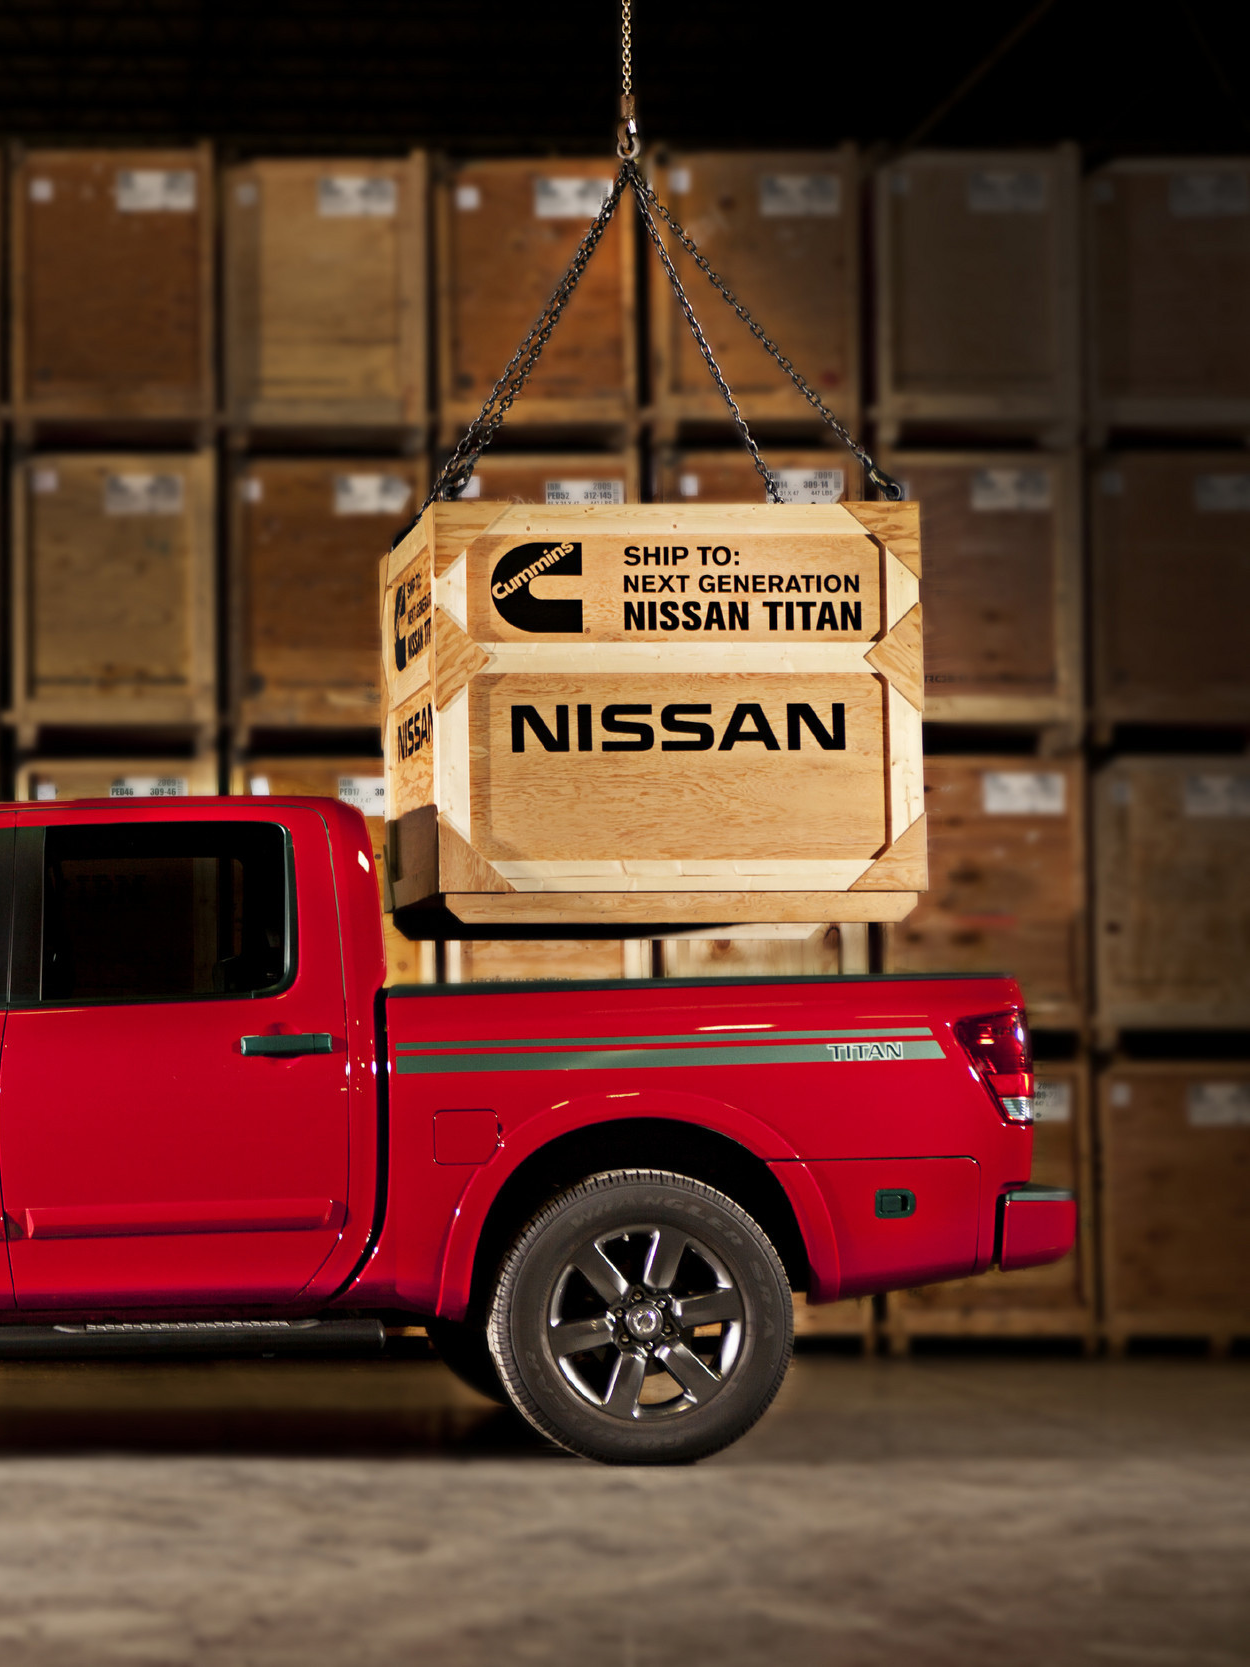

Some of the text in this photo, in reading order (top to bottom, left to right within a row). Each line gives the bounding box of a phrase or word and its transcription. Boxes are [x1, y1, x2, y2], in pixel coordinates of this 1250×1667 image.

[593, 482, 612, 490] 2009
[803, 481, 829, 489] 309-14
[547, 491, 612, 500] PED52 312-145
[623, 546, 740, 566] SHIP TO:
[491, 542, 574, 600] Cummins
[623, 575, 860, 593] NEXT GENERATION
[623, 601, 862, 631] NISSAN TITAN
[511, 703, 846, 752] NISSAN
[111, 788, 177, 796] PED46 309-46
[340, 788, 360, 796] PED17
[827, 1042, 904, 1062] TITAN
[569, 1195, 744, 1247] WRANGLER
